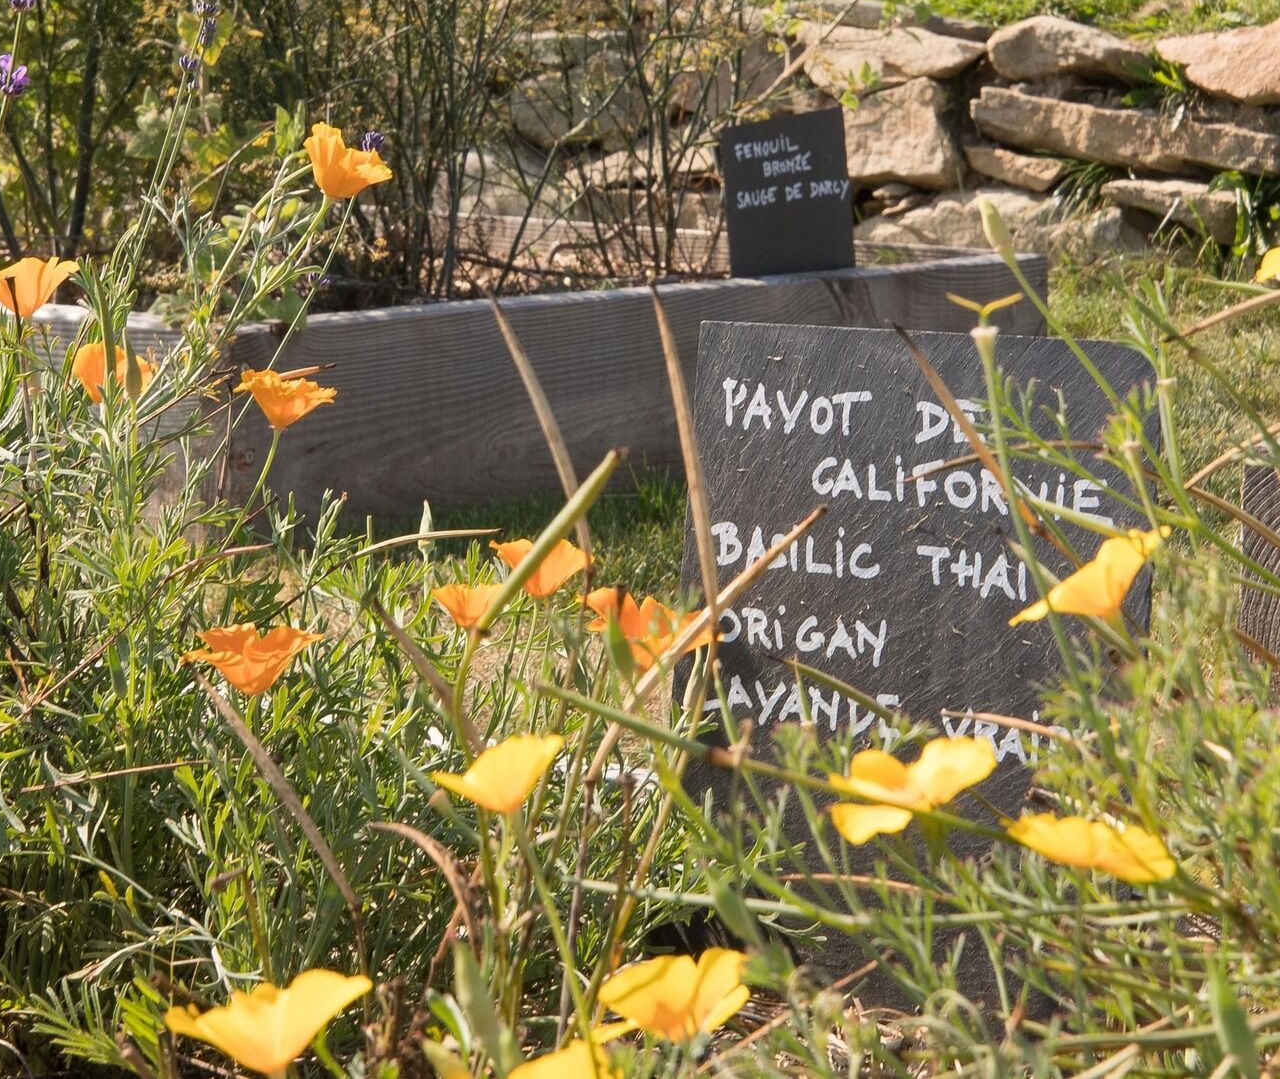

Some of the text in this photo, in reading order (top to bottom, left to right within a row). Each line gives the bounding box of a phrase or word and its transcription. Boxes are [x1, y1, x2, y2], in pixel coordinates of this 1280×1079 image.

[763, 150, 812, 178] BRONZE
[736, 179, 850, 209] SAUGE DE DARCY
[722, 377, 988, 444] PAVOT DE
